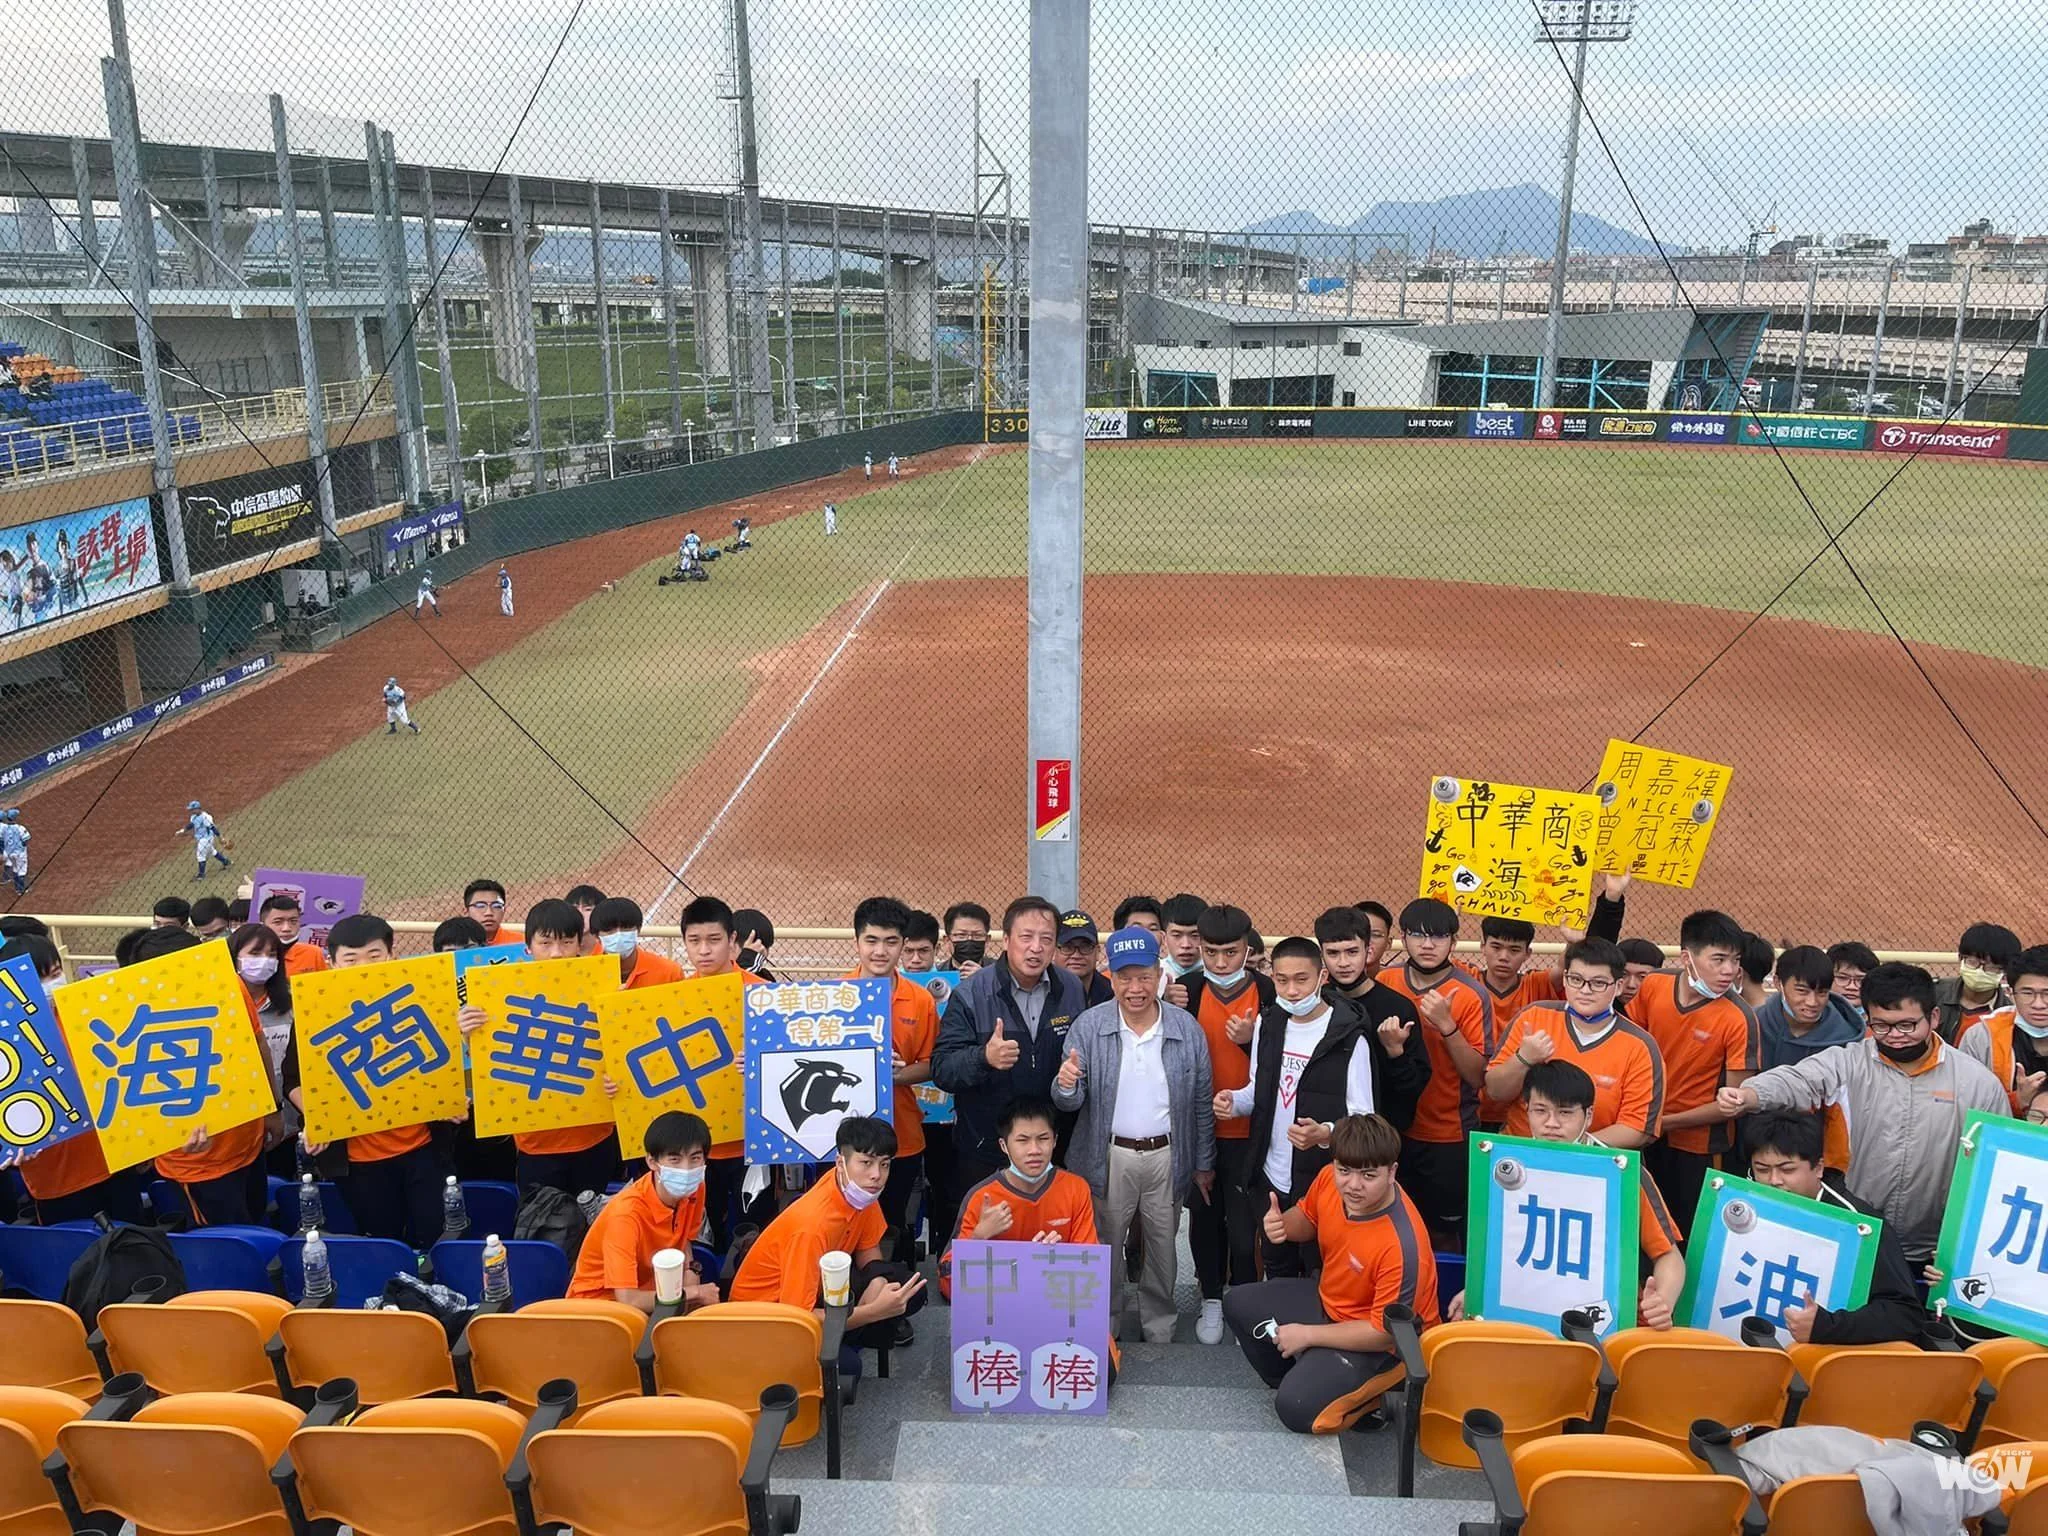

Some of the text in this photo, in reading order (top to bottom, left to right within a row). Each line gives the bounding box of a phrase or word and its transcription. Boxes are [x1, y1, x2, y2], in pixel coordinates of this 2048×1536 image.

[990, 418, 1029, 433] 330
[1408, 419, 1454, 427] LINE TODAY
[1476, 412, 1514, 430] best
[1819, 428, 1858, 441] CTBC
[1908, 430, 1994, 449] Transcend
[1626, 796, 1679, 816] NICE
[1455, 799, 1572, 850] 中華商
[1485, 857, 1529, 890] 海
[1113, 938, 1146, 954] CHMVS
[310, 983, 451, 1110] 商
[489, 993, 603, 1101] 華
[90, 1003, 223, 1129] 海
[625, 1016, 735, 1110] 中
[1516, 1194, 1593, 1281] 加
